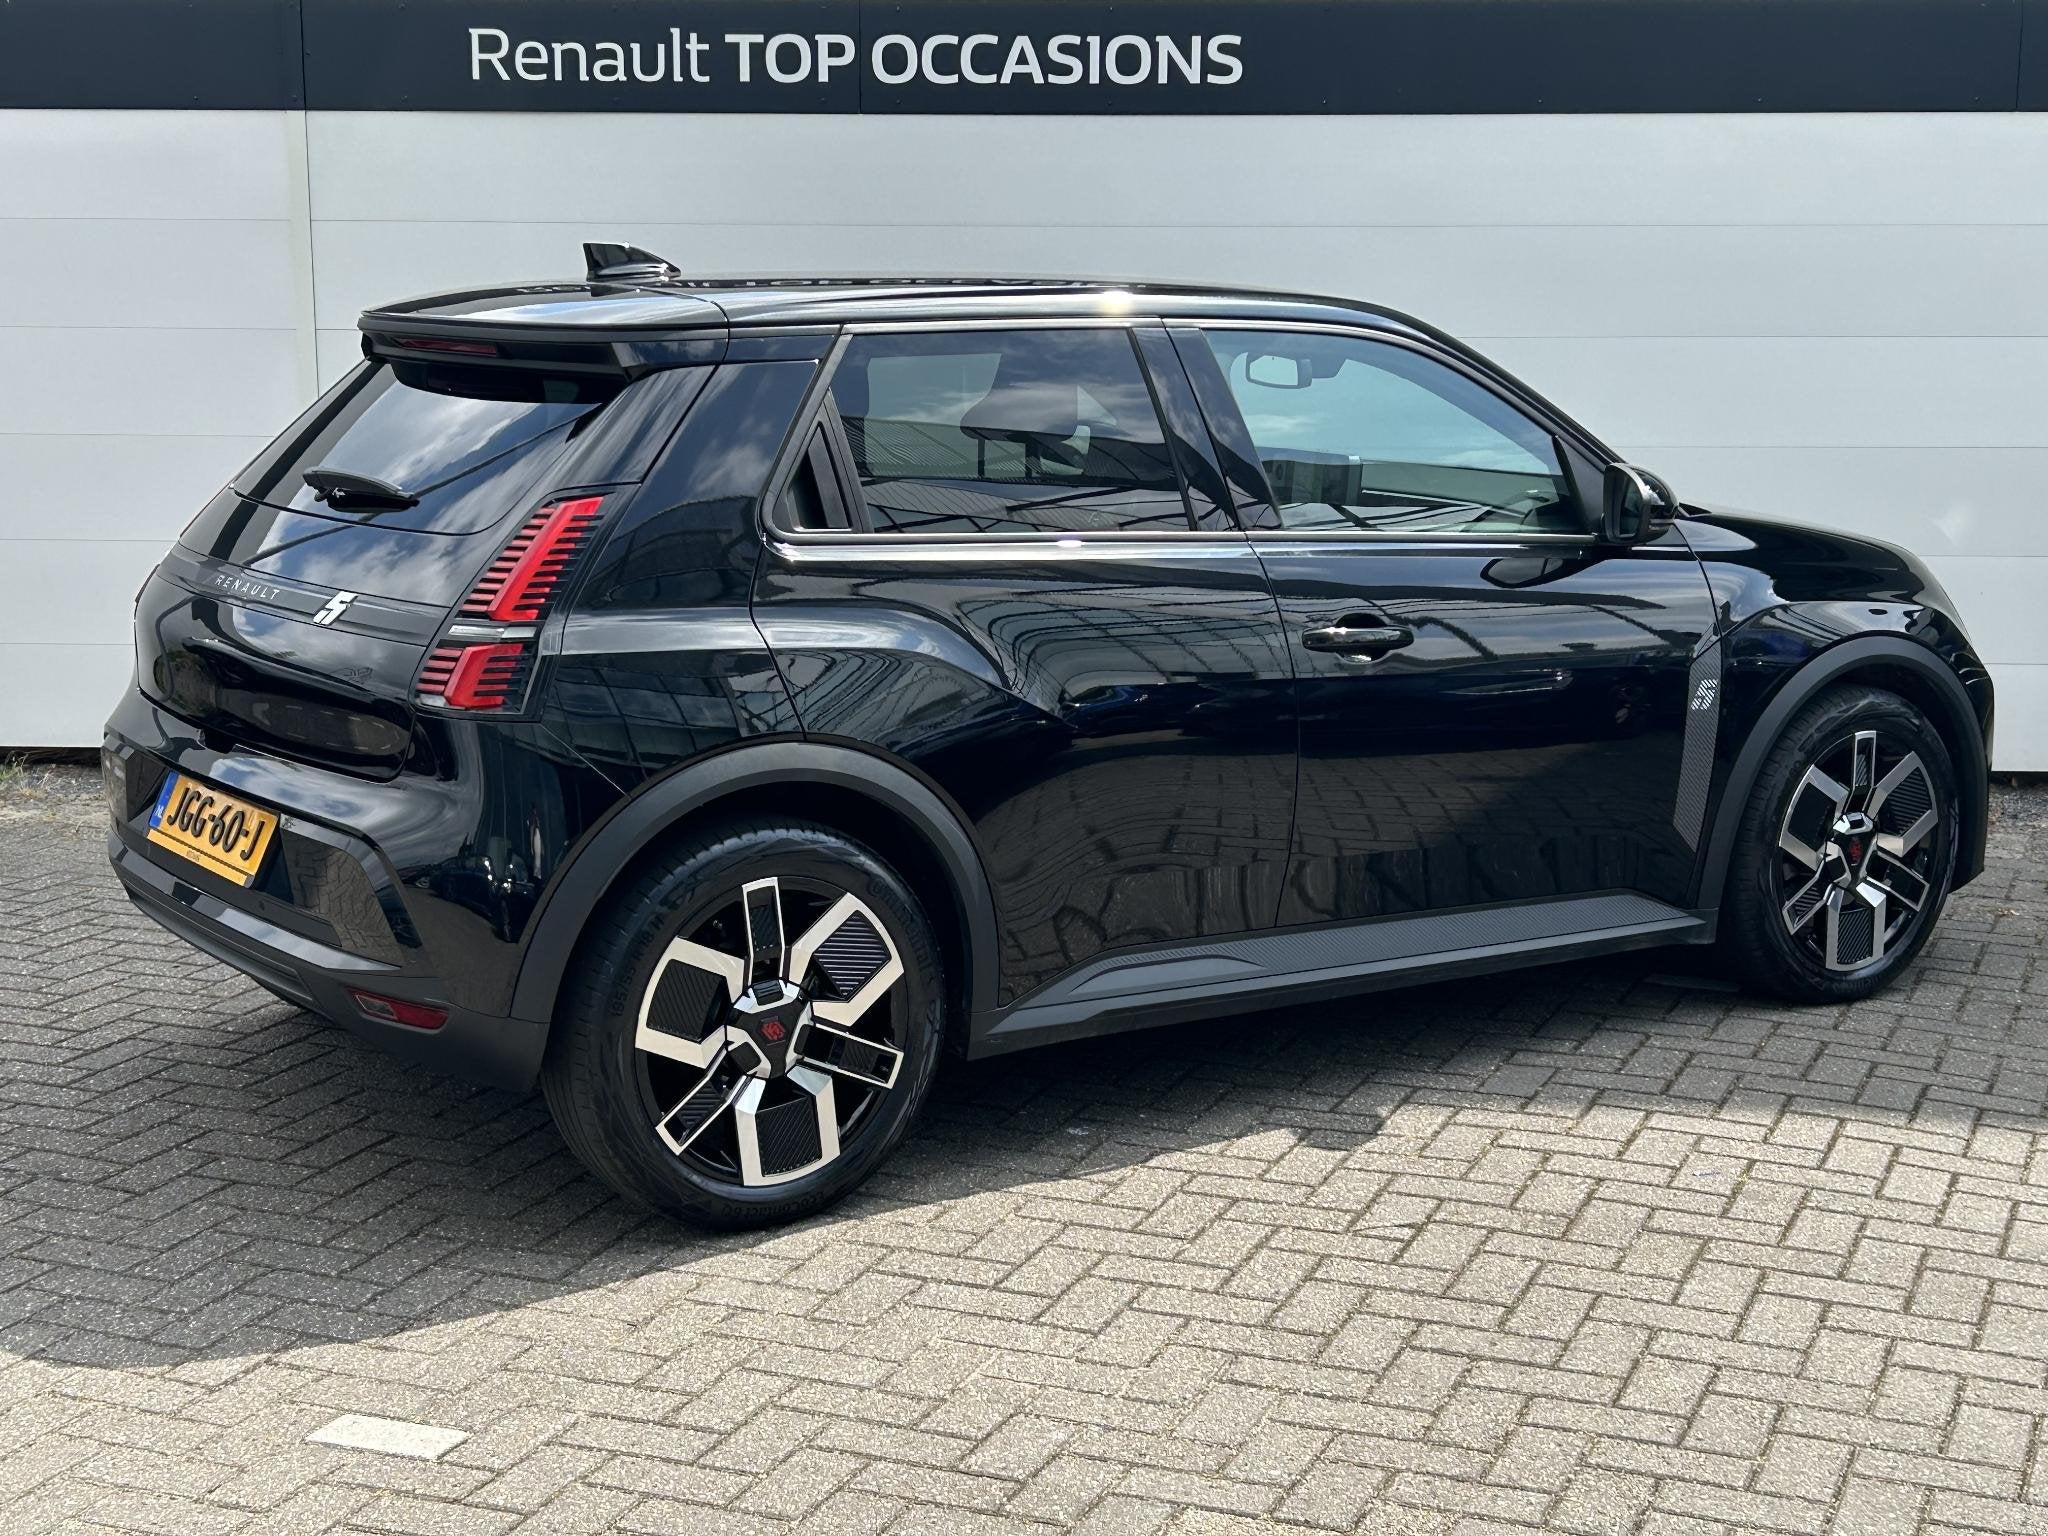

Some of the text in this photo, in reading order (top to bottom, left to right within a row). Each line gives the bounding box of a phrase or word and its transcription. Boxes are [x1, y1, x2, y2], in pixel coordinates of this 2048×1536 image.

[468, 27, 1244, 85] Renault TOP OCCASIONS
[214, 574, 280, 600] RENAULT
[166, 786, 266, 861] JGG-60-J
